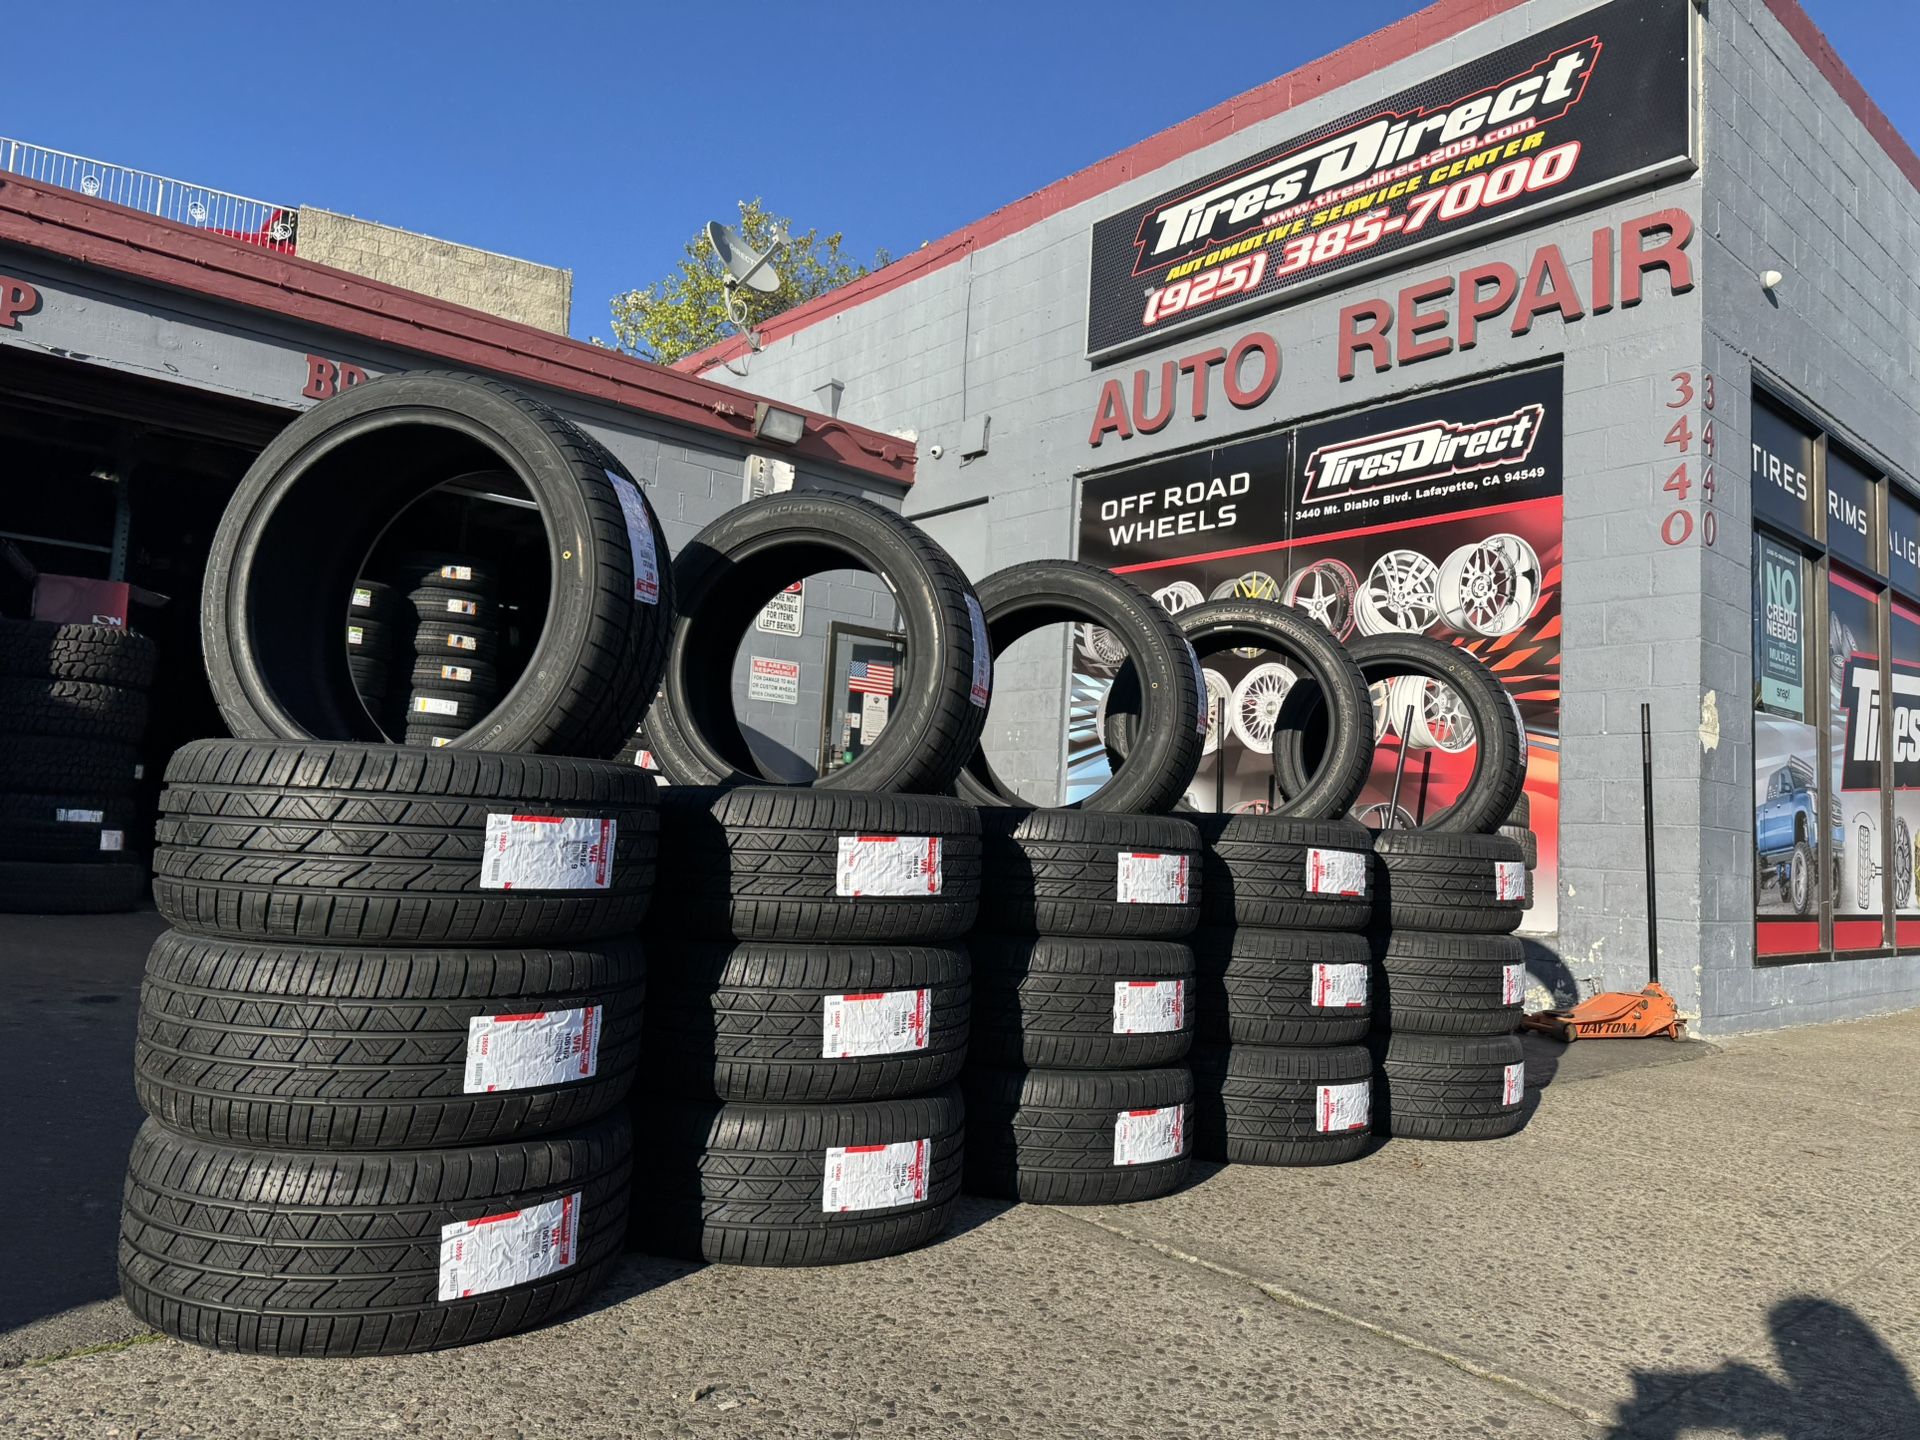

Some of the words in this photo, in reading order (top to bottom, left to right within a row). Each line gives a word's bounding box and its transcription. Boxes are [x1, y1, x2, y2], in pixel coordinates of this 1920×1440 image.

[1262, 117, 1536, 226] www.tiresdirect209.com
[1165, 219, 1306, 282] AUTOMOTIVE
[1311, 176, 1422, 227] SERVICE
[1429, 131, 1545, 184] CENTER
[1143, 252, 1268, 326] (925)
[1277, 141, 1581, 276] 385-7000
[1089, 332, 1284, 448] AUTO
[1337, 208, 1696, 383] REPAIR
[1660, 372, 1694, 546] 3440
[1752, 443, 1807, 501] TIRES
[1101, 491, 1156, 521] OFF
[1164, 472, 1250, 509] ROAD
[1295, 508, 1321, 520] 3440
[1323, 502, 1341, 515] Mt.
[1344, 498, 1380, 512] Diablo
[1383, 491, 1412, 505] Blvd.
[1416, 478, 1478, 500] Lafayette,
[1482, 475, 1501, 487] CA
[1504, 467, 1545, 483] 94549
[1828, 489, 1868, 536] RIMS
[1109, 504, 1237, 546] WHEELS
[1766, 561, 1797, 614] NO
[766, 602, 798, 614] ESPONSIBLE
[786, 595, 797, 604] NOT
[92, 614, 122, 626] ION
[766, 610, 777, 619] FOR
[778, 612, 794, 622] ITEMS
[1766, 602, 1797, 623] CREDIT
[763, 619, 776, 629] LEFT
[776, 621, 796, 632] BEHIND
[1766, 619, 1798, 644] NEEDED
[1769, 647, 1796, 667] MULTIPLE
[589, 844, 598, 864] WR
[920, 858, 927, 875] WR
[908, 1012, 916, 1029] WR
[1579, 1022, 1637, 1034] DAYTONA
[481, 1033, 489, 1056] 126550
[572, 1033, 583, 1054] WR
[908, 1164, 915, 1181] WR
[541, 1225, 549, 1254] 106162
[551, 1226, 561, 1249] WR
